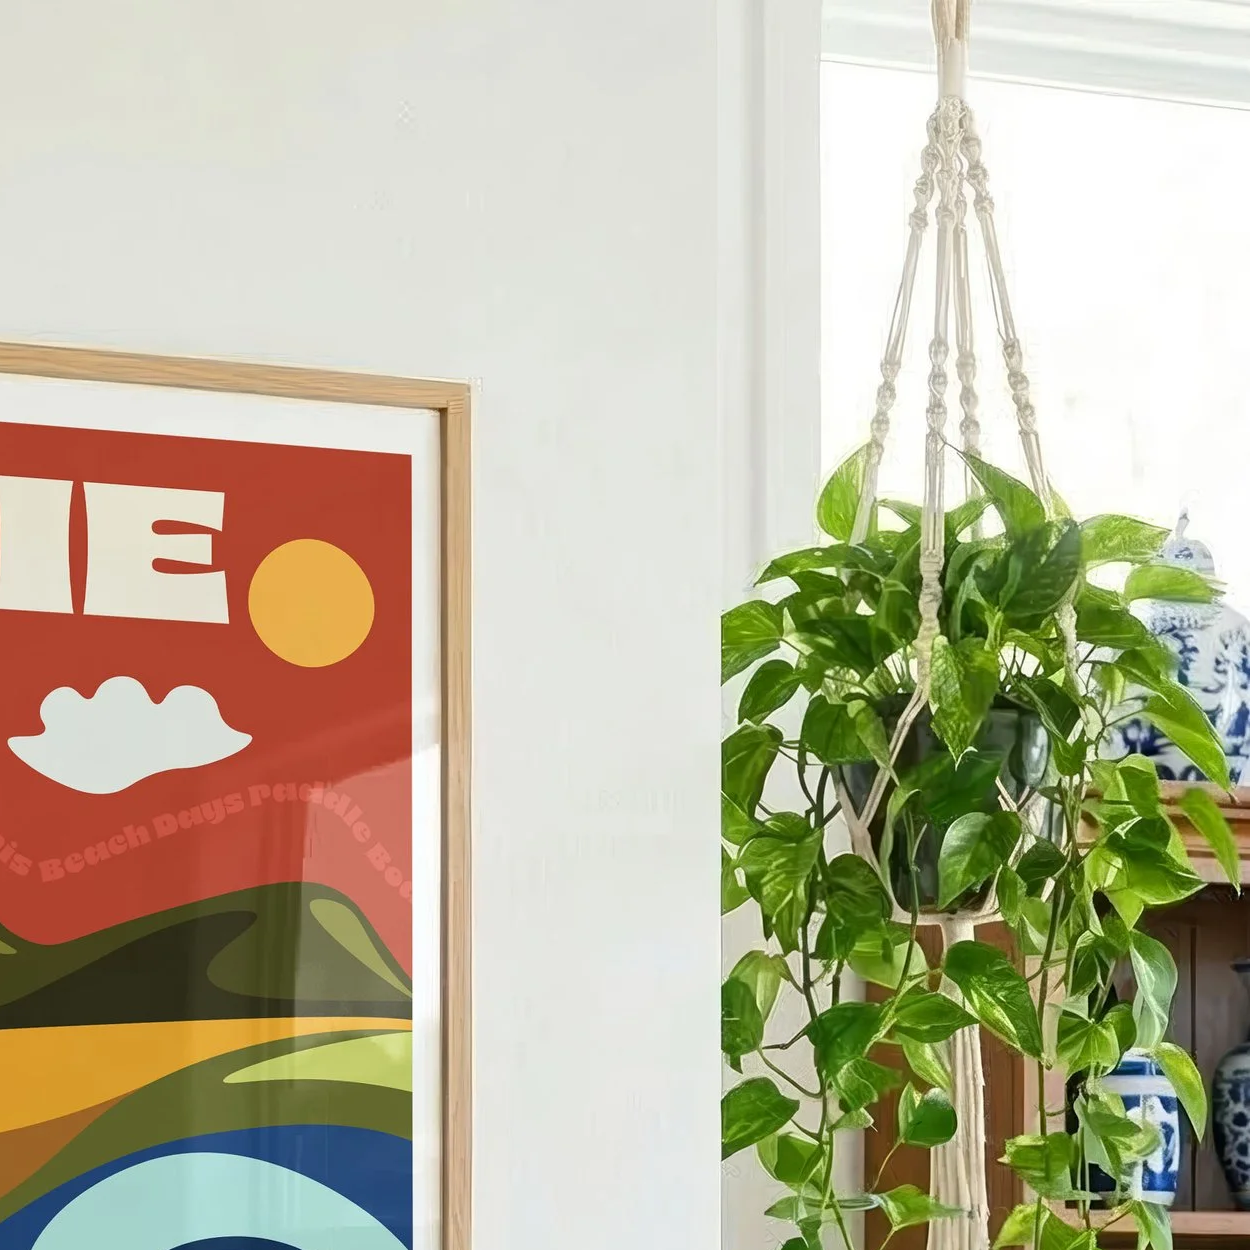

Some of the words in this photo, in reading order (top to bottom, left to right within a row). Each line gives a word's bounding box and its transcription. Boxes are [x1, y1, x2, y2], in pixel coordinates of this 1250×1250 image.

[38, 824, 150, 882] Beach
[152, 792, 245, 839] Days
[248, 781, 371, 843] Paddle
